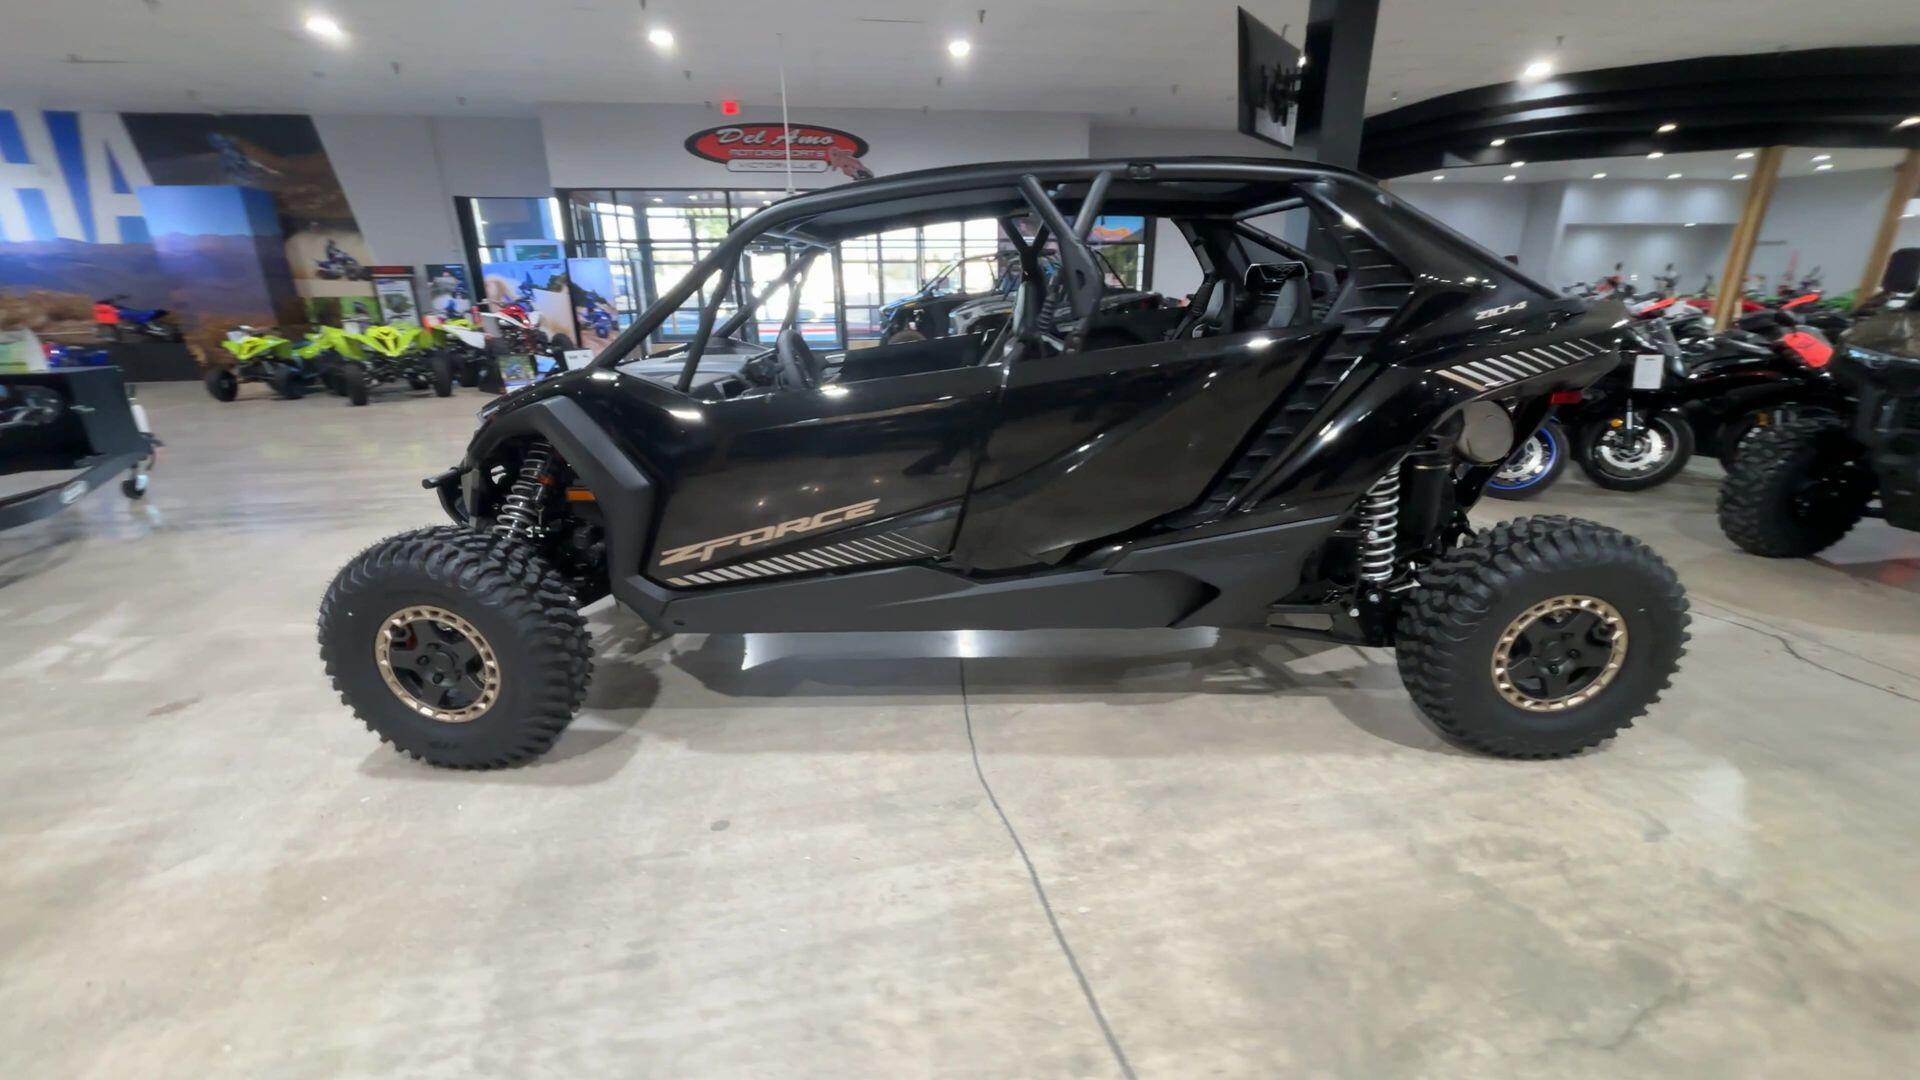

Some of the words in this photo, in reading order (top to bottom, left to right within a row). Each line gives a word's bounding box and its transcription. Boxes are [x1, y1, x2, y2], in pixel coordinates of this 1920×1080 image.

[716, 128, 767, 144] Del
[772, 128, 834, 146] Amo
[659, 498, 880, 566] ZFORCE
